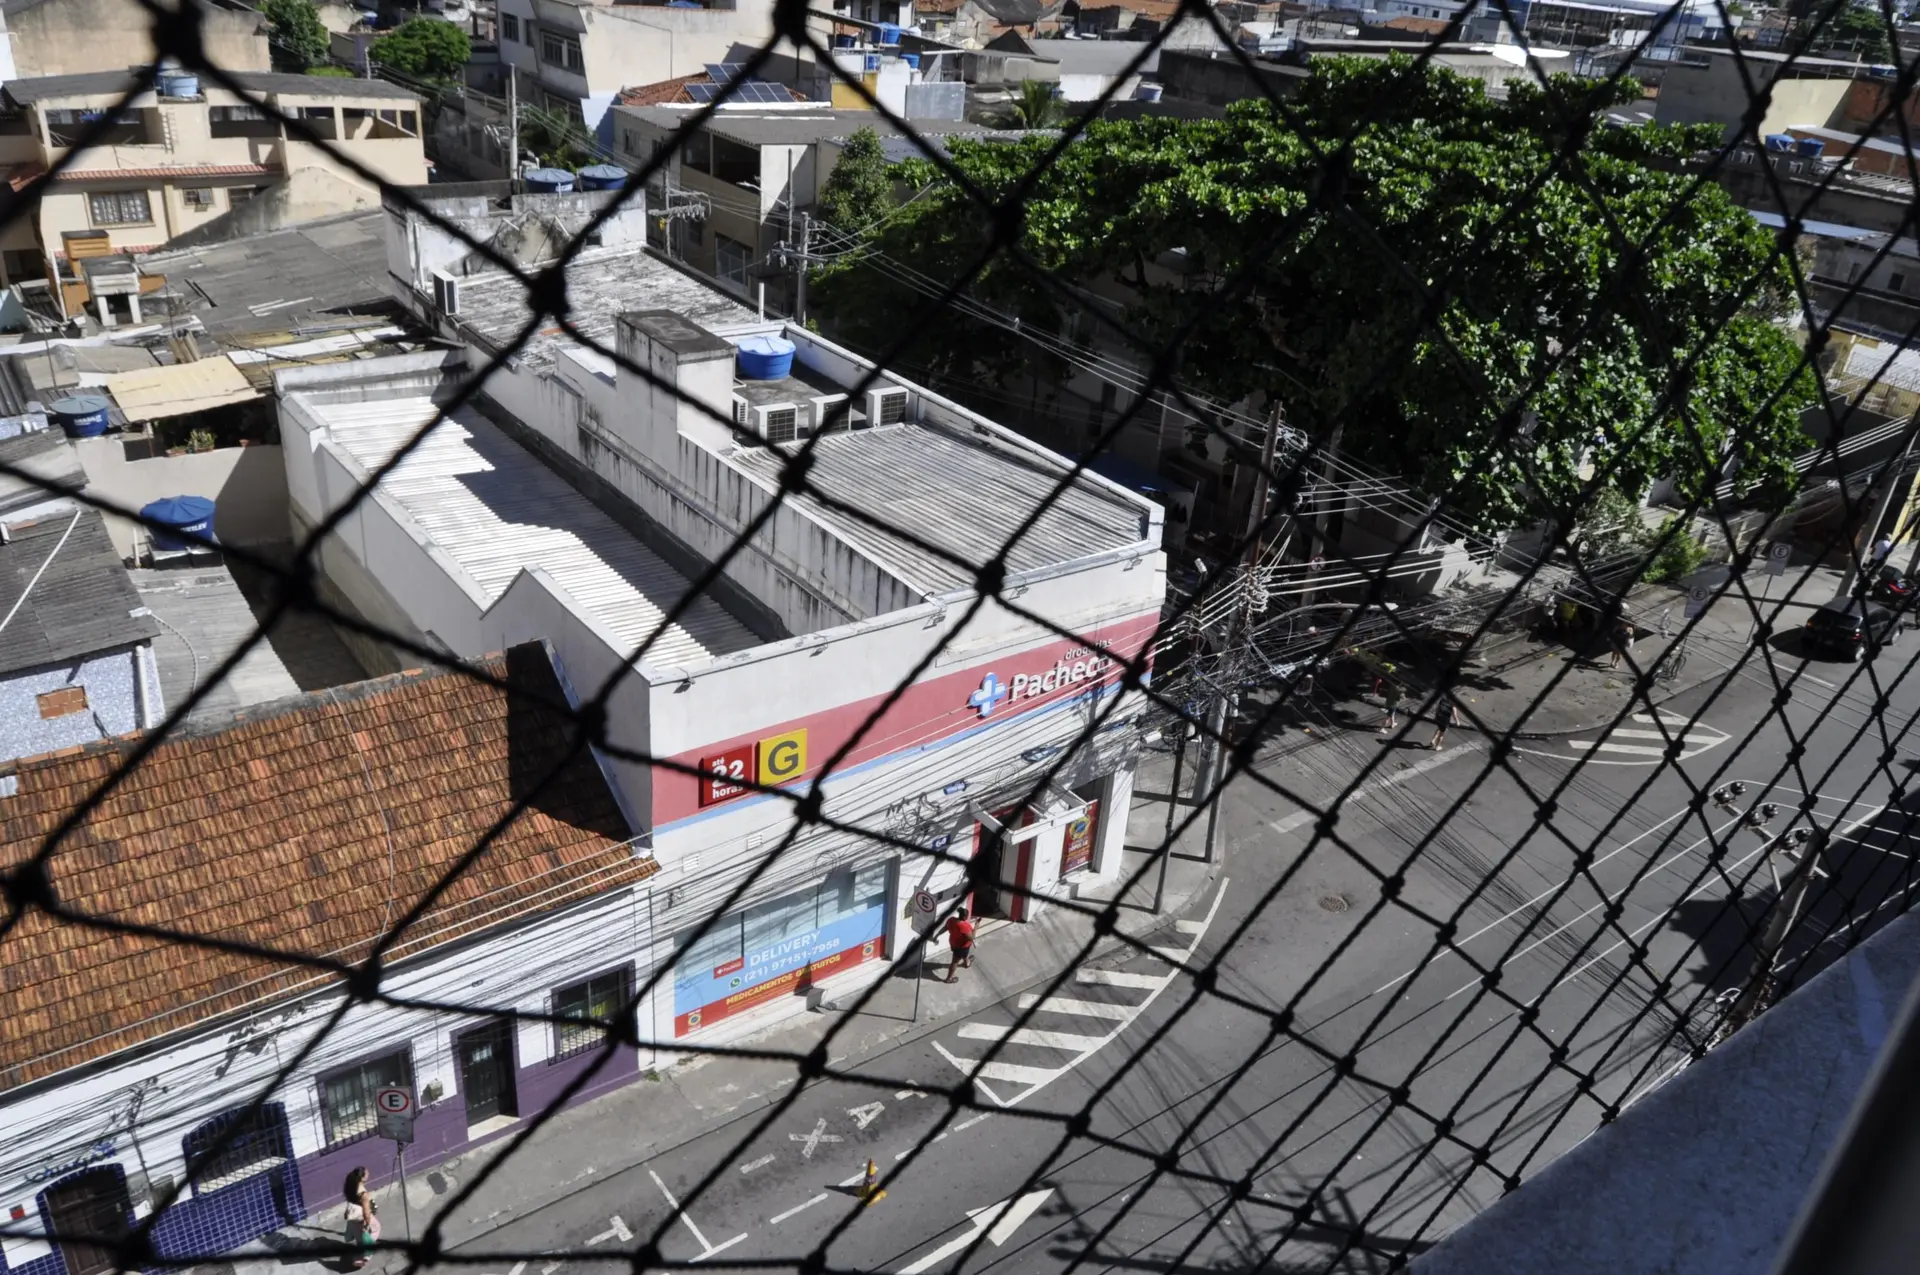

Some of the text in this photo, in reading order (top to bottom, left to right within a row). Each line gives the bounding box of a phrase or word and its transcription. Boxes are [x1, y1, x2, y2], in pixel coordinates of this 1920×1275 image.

[768, 740, 799, 776] G
[712, 760, 744, 788] 22
[712, 785, 744, 799] horas
[921, 895, 930, 909] E
[750, 930, 820, 967] DELIVERY
[744, 966, 769, 983] (21)
[726, 973, 793, 1006] MEDICAMENTOS
[388, 1094, 400, 1107] E
